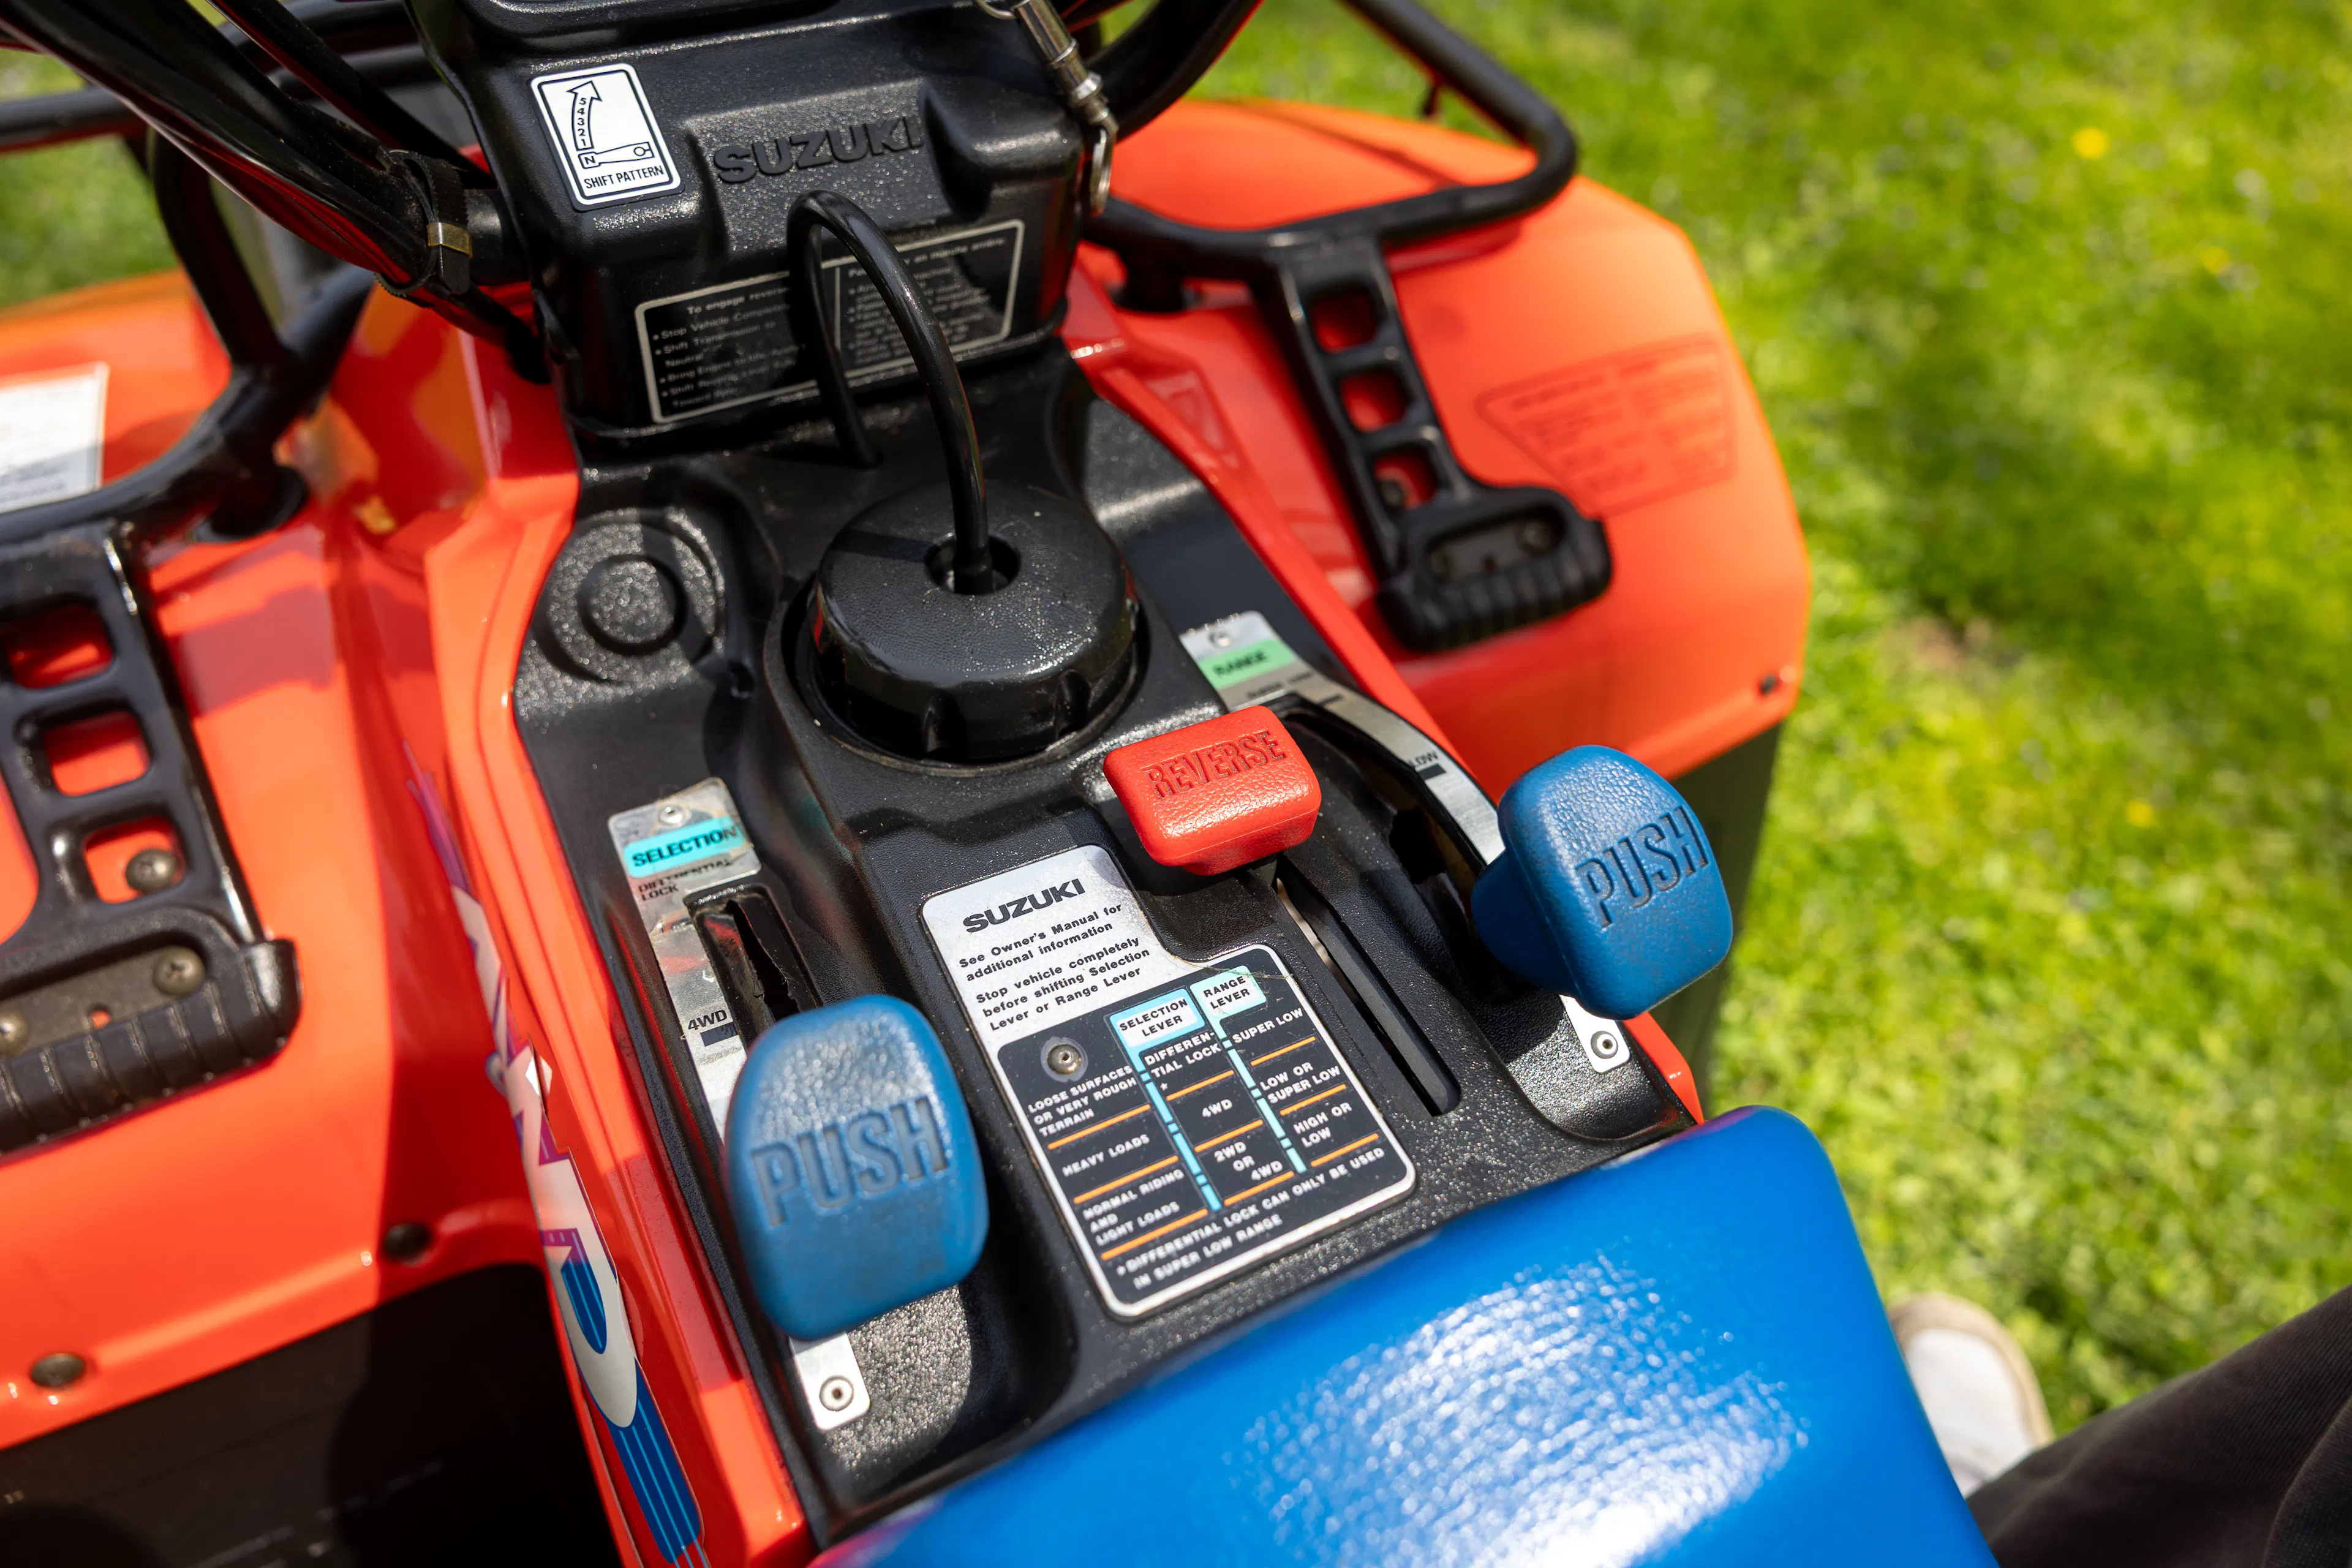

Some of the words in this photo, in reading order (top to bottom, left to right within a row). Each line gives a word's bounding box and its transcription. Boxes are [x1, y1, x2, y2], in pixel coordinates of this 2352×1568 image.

[578, 128, 586, 137] 2
[713, 116, 924, 184] SUZUKI
[584, 156, 596, 165] N
[584, 175, 614, 189] SHIFT
[616, 165, 665, 186] PATTERN
[687, 306, 702, 315] To
[705, 296, 745, 311] engage
[1139, 729, 1287, 798] REVERSE
[631, 827, 737, 867] SELECTION
[1574, 805, 1709, 929] PUSH
[641, 883, 680, 901] LOCK
[963, 878, 1086, 933] SUZUKI
[959, 953, 986, 968] See
[990, 932, 1046, 957] Owner's
[1050, 911, 1099, 935] Manual
[1103, 903, 1122, 916] for
[967, 949, 1035, 981] additional
[1038, 922, 1114, 955] information
[976, 986, 1008, 1003] Stop
[1014, 966, 1063, 989] vehicle
[1068, 936, 1140, 970] completely
[982, 995, 1028, 1017] before
[1033, 973, 1084, 998] shifting
[1088, 949, 1150, 976] Selection
[1202, 976, 1246, 998] RANGE
[989, 1009, 1030, 1031] Lever
[1035, 1002, 1049, 1014] or
[1055, 984, 1098, 1006] Range
[1103, 967, 1141, 987] Lever
[1118, 998, 1189, 1031] SELECTION
[1209, 988, 1251, 1010] LEVER
[688, 1009, 728, 1030] 4WD
[1141, 1015, 1183, 1038] LEVER
[1231, 1019, 1276, 1044] SUPER
[1275, 1008, 1305, 1026] LOW
[1144, 1031, 1215, 1066] DIFFEREN-
[1150, 1058, 1183, 1078] TIAL
[1184, 1043, 1223, 1065] LOCK
[1027, 1090, 1069, 1114] LOOSE
[1069, 1065, 1133, 1097] SURFACES
[1259, 1071, 1289, 1091] LOW
[1292, 1061, 1314, 1076] OR
[1267, 1079, 1312, 1104] SUPER
[1311, 1065, 1341, 1085] LOW
[1033, 1111, 1054, 1125] OR
[1055, 1096, 1089, 1116] VERY
[1093, 1077, 1137, 1102] ROUGH
[1201, 1099, 1234, 1118] 4WD
[1292, 1112, 1329, 1134] HIGH
[1330, 1102, 1353, 1117] OR
[1039, 1108, 1095, 1137] TERRAIN
[1301, 1126, 1332, 1148] LOW
[750, 1095, 950, 1227] PUSH
[1061, 1151, 1105, 1177] HEAVY
[1107, 1133, 1150, 1158] LOADS
[1213, 1141, 1247, 1163] 2WD
[1232, 1155, 1256, 1172] OR
[1250, 1160, 1283, 1181] 4WD
[1082, 1190, 1139, 1221] NORMAL
[1138, 1169, 1185, 1196] RIDING
[1125, 1221, 1223, 1273] DIFFERENTIAL
[1223, 1204, 1261, 1228] LOCK
[1261, 1190, 1291, 1210] CAN
[1291, 1173, 1327, 1197] ONLY
[1328, 1164, 1349, 1180] BE
[1349, 1147, 1385, 1170] USED
[1089, 1213, 1119, 1234] AND
[1095, 1221, 1134, 1246] LIGHT
[1136, 1200, 1181, 1228] LOADS
[1133, 1272, 1152, 1290] IN
[1152, 1251, 1202, 1281] SUPER
[1202, 1235, 1233, 1258] LOW
[1235, 1213, 1283, 1243] RANGE
